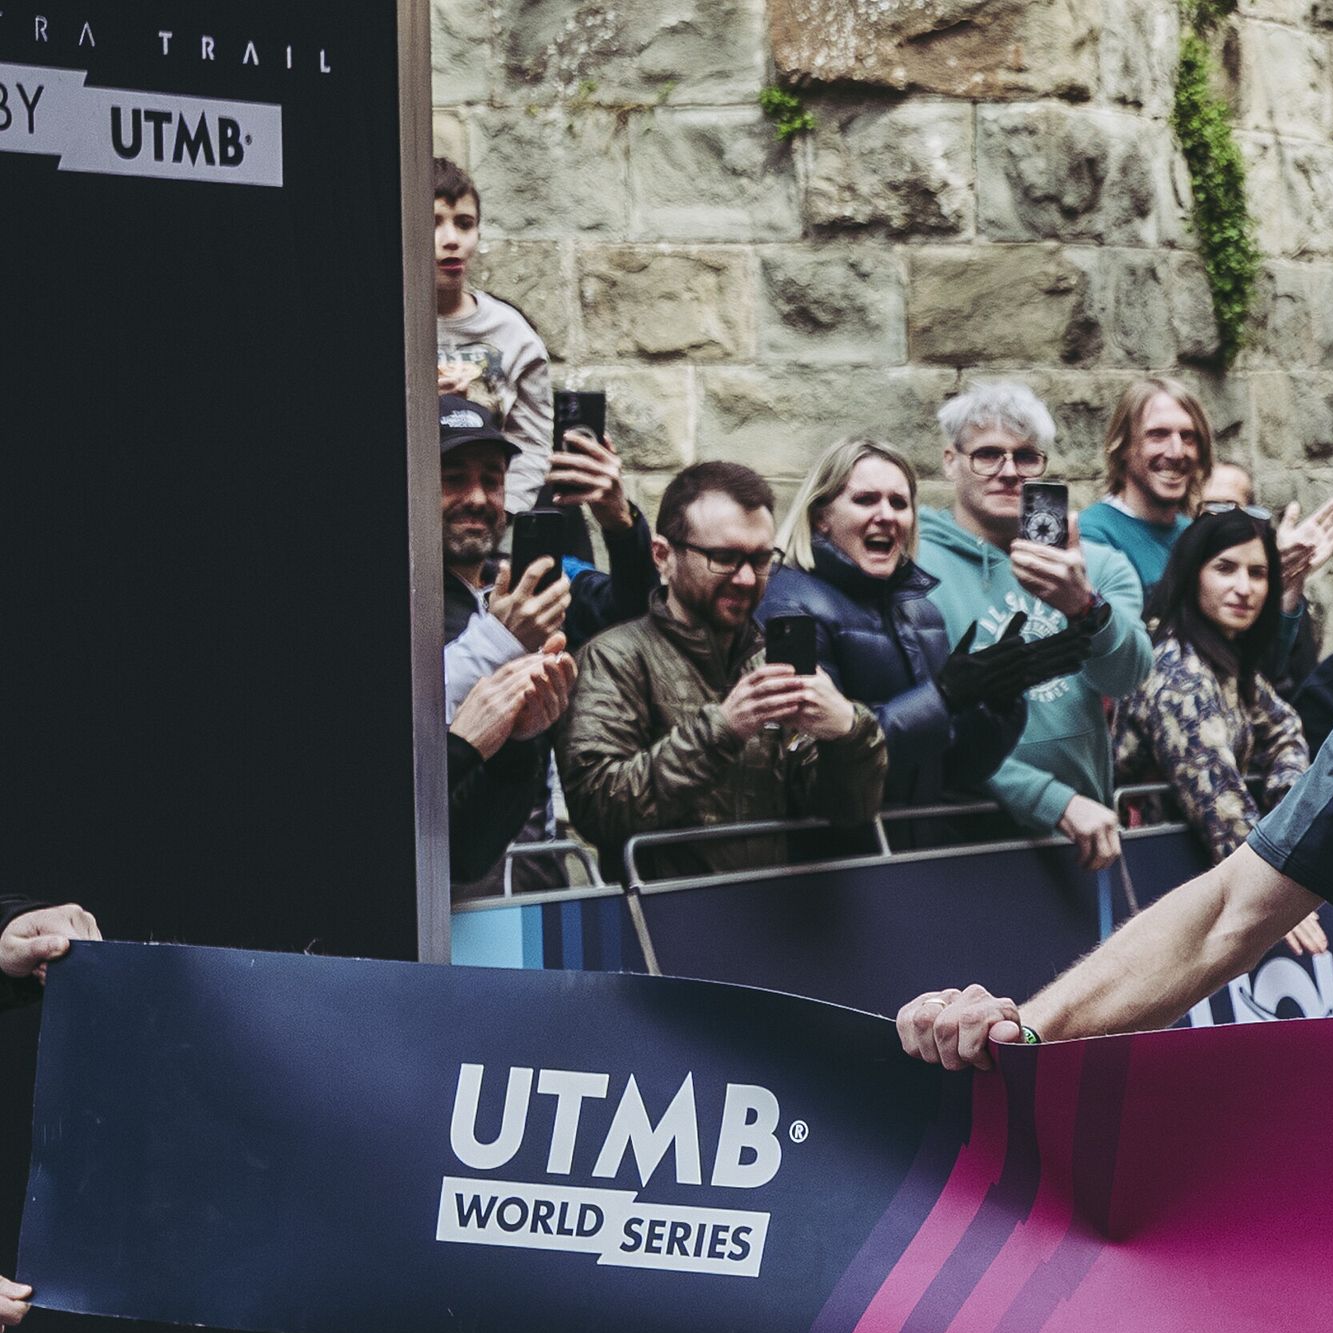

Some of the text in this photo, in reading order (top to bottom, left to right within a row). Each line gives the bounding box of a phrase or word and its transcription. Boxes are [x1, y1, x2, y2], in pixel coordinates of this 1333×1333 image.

[158, 30, 332, 74] TRAIL
[454, 1192, 753, 1262] WORLD SERIES
